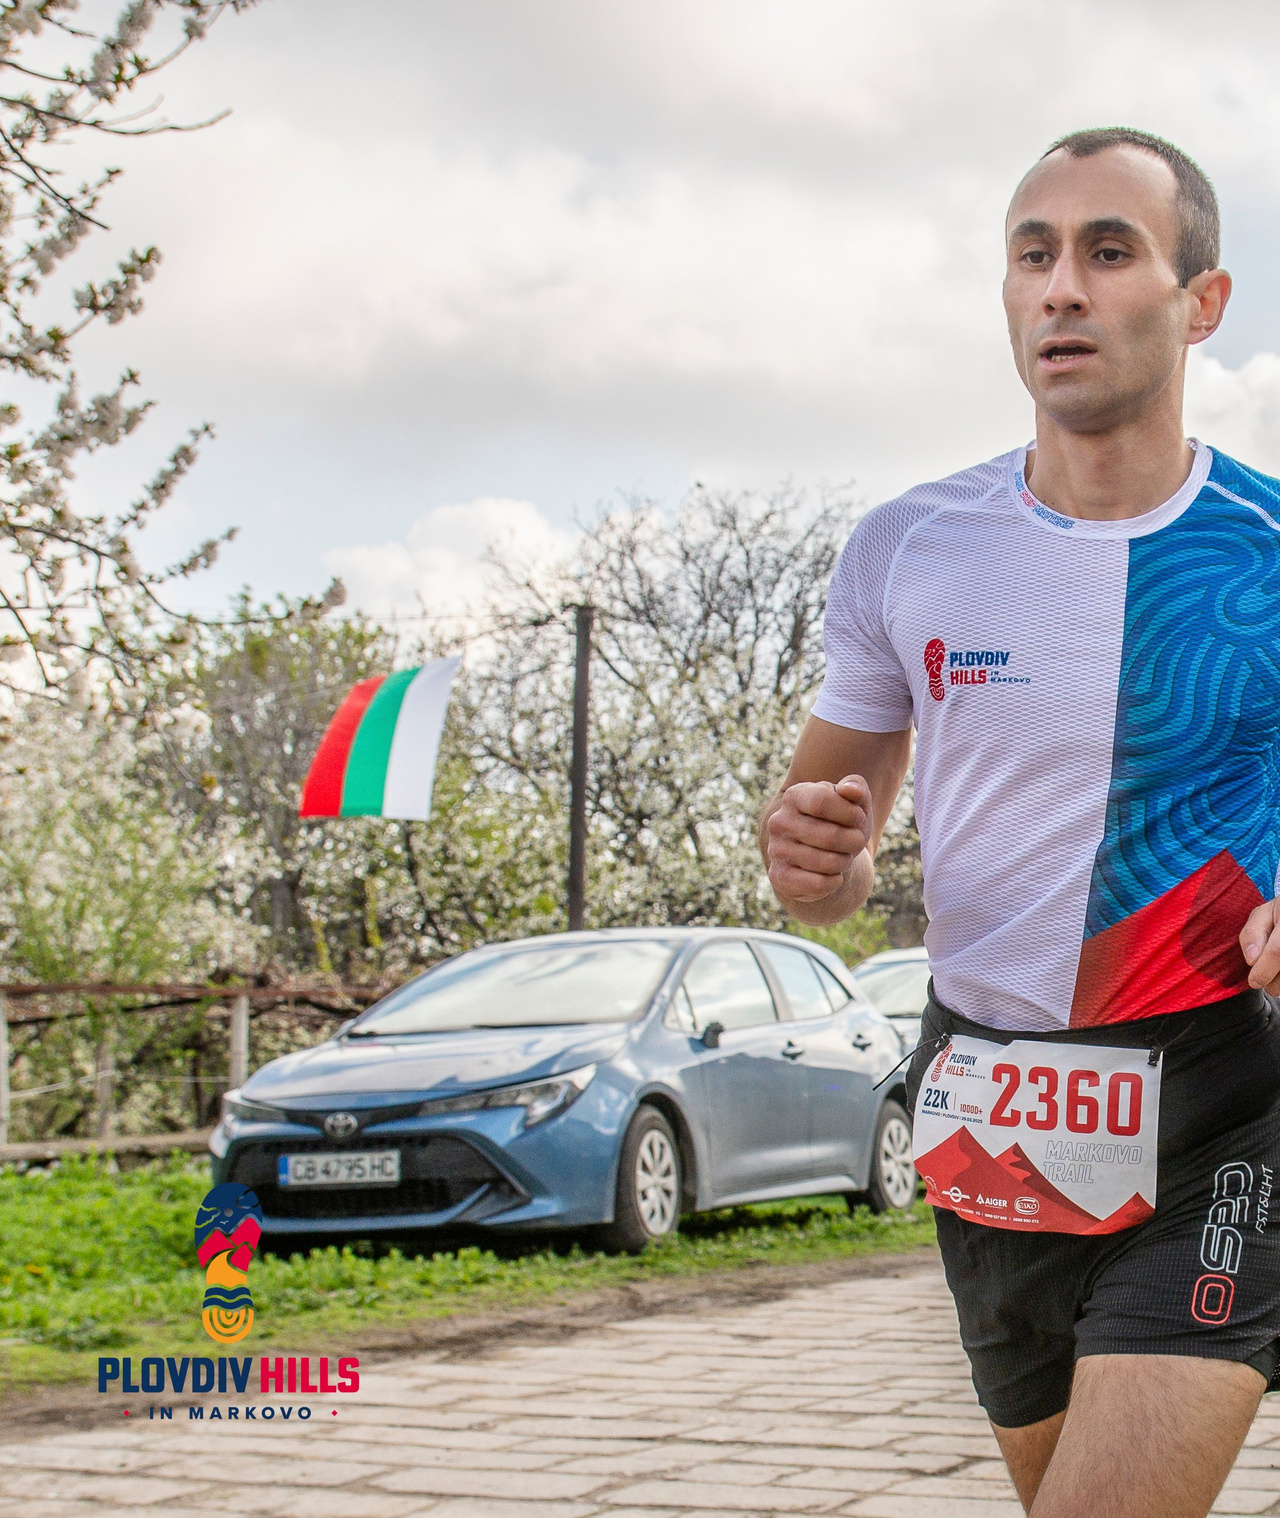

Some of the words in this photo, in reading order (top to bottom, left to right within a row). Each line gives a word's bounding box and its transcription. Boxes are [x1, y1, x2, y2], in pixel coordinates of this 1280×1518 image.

[950, 651, 1010, 667] PLOVDIV
[950, 669, 987, 685] HILLS
[949, 1053, 977, 1066] PLOVDIV
[945, 1065, 965, 1077] HILLS
[924, 1088, 950, 1110] 22K
[990, 1063, 1143, 1136] 2360
[1045, 1140, 1143, 1165] MARKOVO
[369, 1155, 394, 1177] HC
[1043, 1162, 1094, 1184] TRAIL
[985, 1197, 1008, 1208] AIGER
